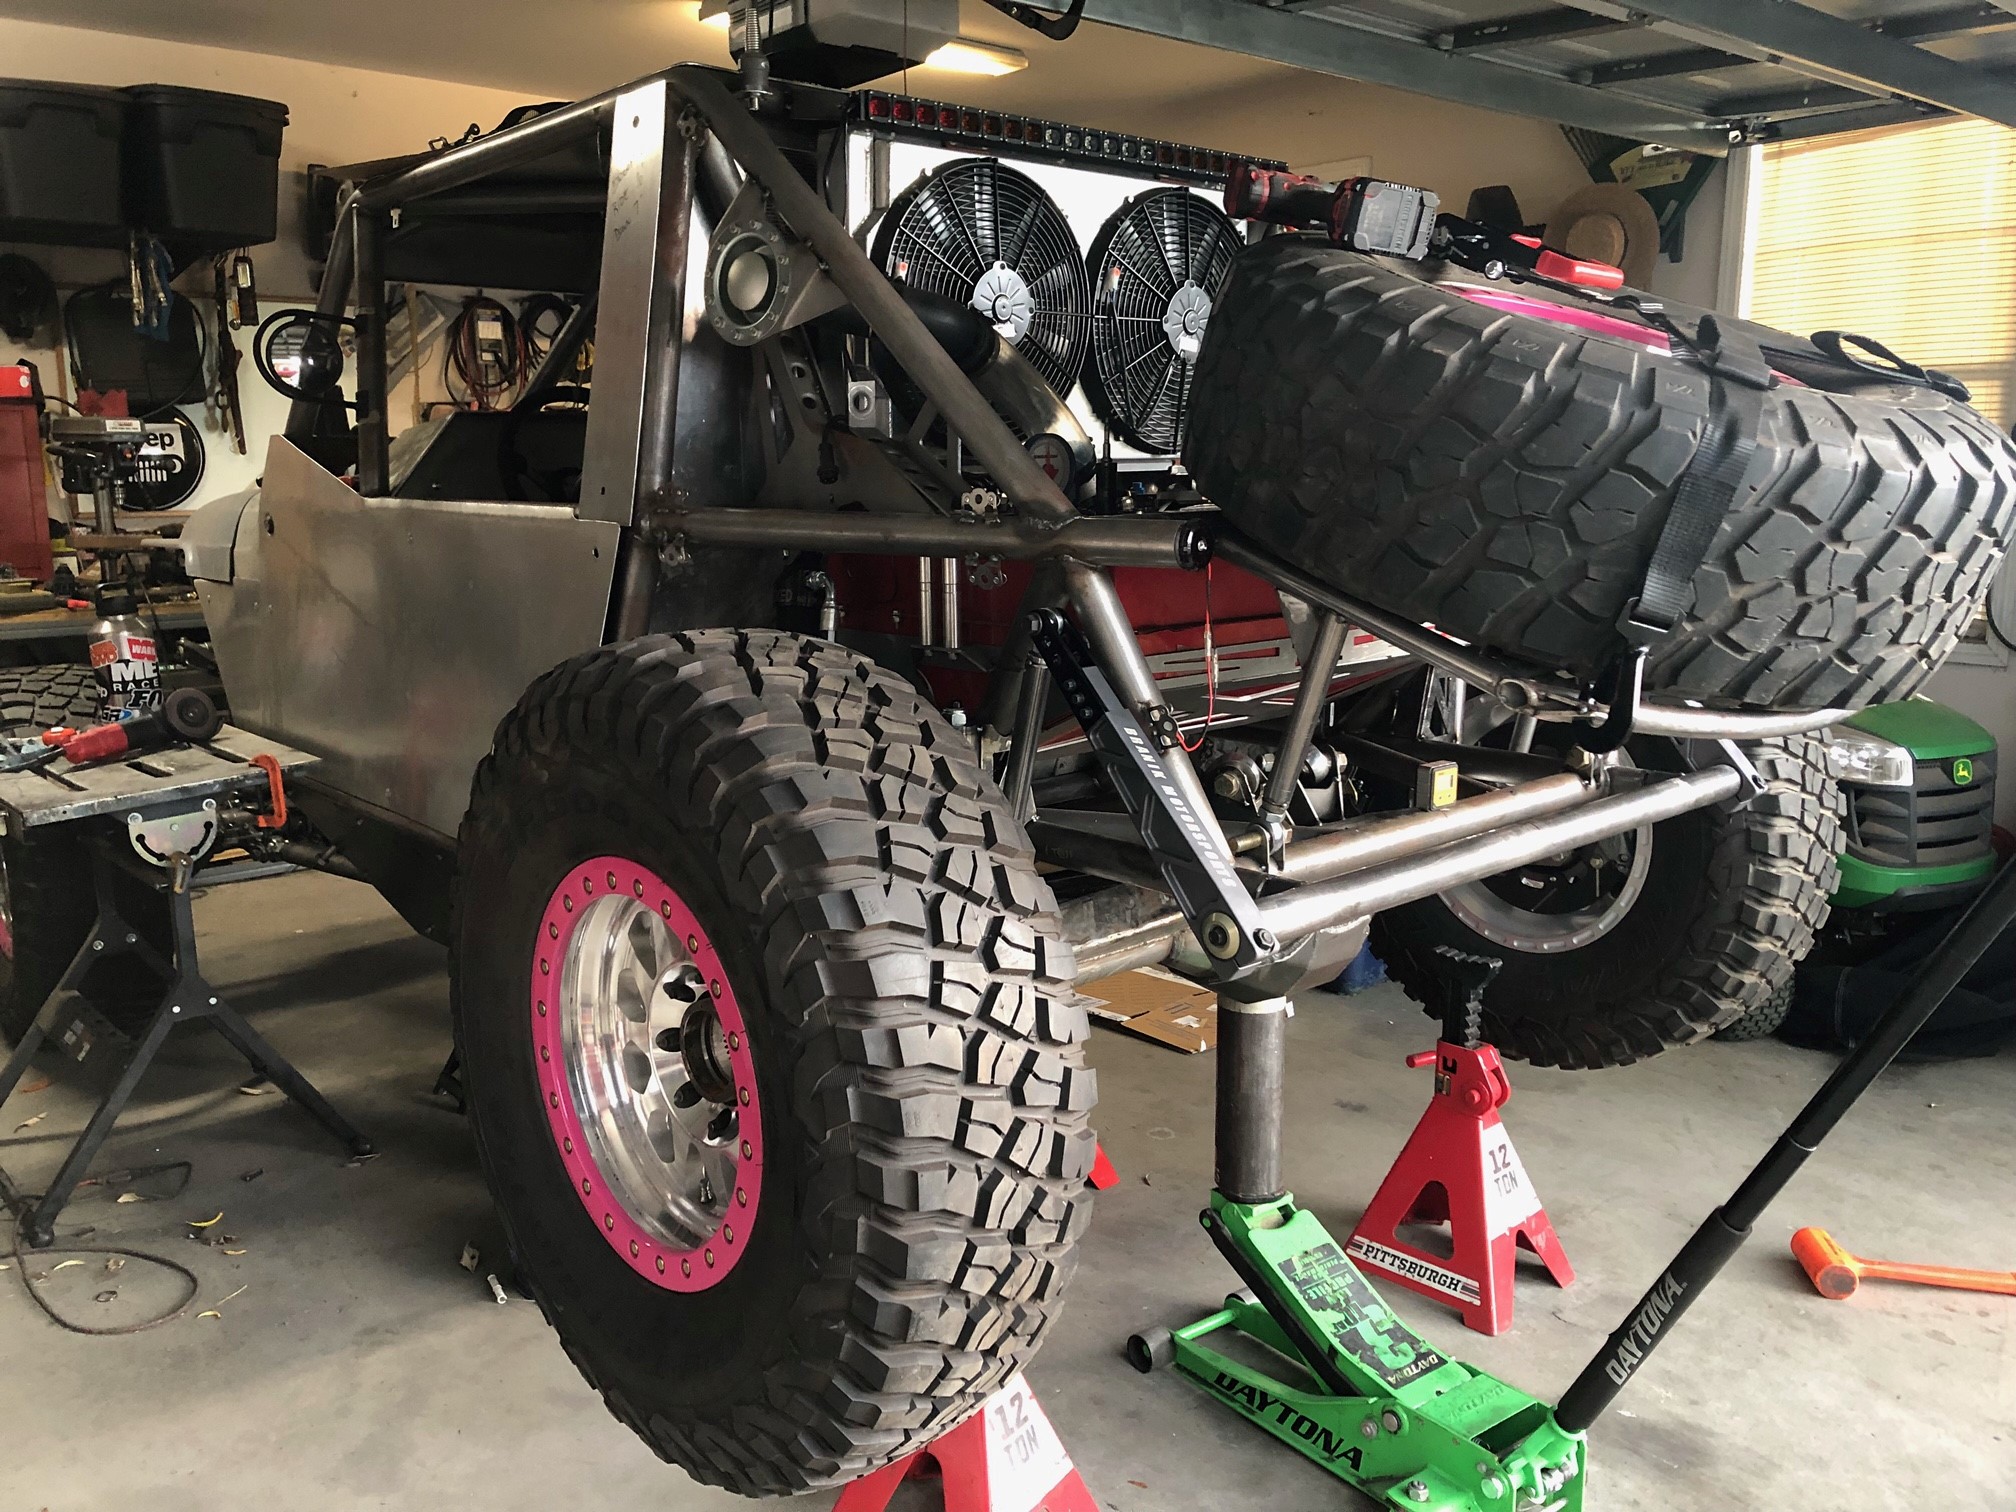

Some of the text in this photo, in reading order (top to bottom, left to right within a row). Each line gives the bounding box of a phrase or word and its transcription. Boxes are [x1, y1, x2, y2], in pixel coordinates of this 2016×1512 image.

[146, 432, 174, 451] ep
[1123, 727, 1237, 888] BRANIK MOTORSPORTS
[1489, 1144, 1511, 1175] 12
[1494, 1169, 1519, 1198] TON
[1362, 1242, 1463, 1293] PITTSBURGH
[1357, 1304, 1417, 1370] 3
[1605, 1271, 1684, 1386] DAYTONA
[1387, 1354, 1439, 1385] DAYTONA
[995, 1391, 1029, 1440] 12
[1214, 1371, 1363, 1472] DAYTONA
[1003, 1424, 1040, 1471] TON
